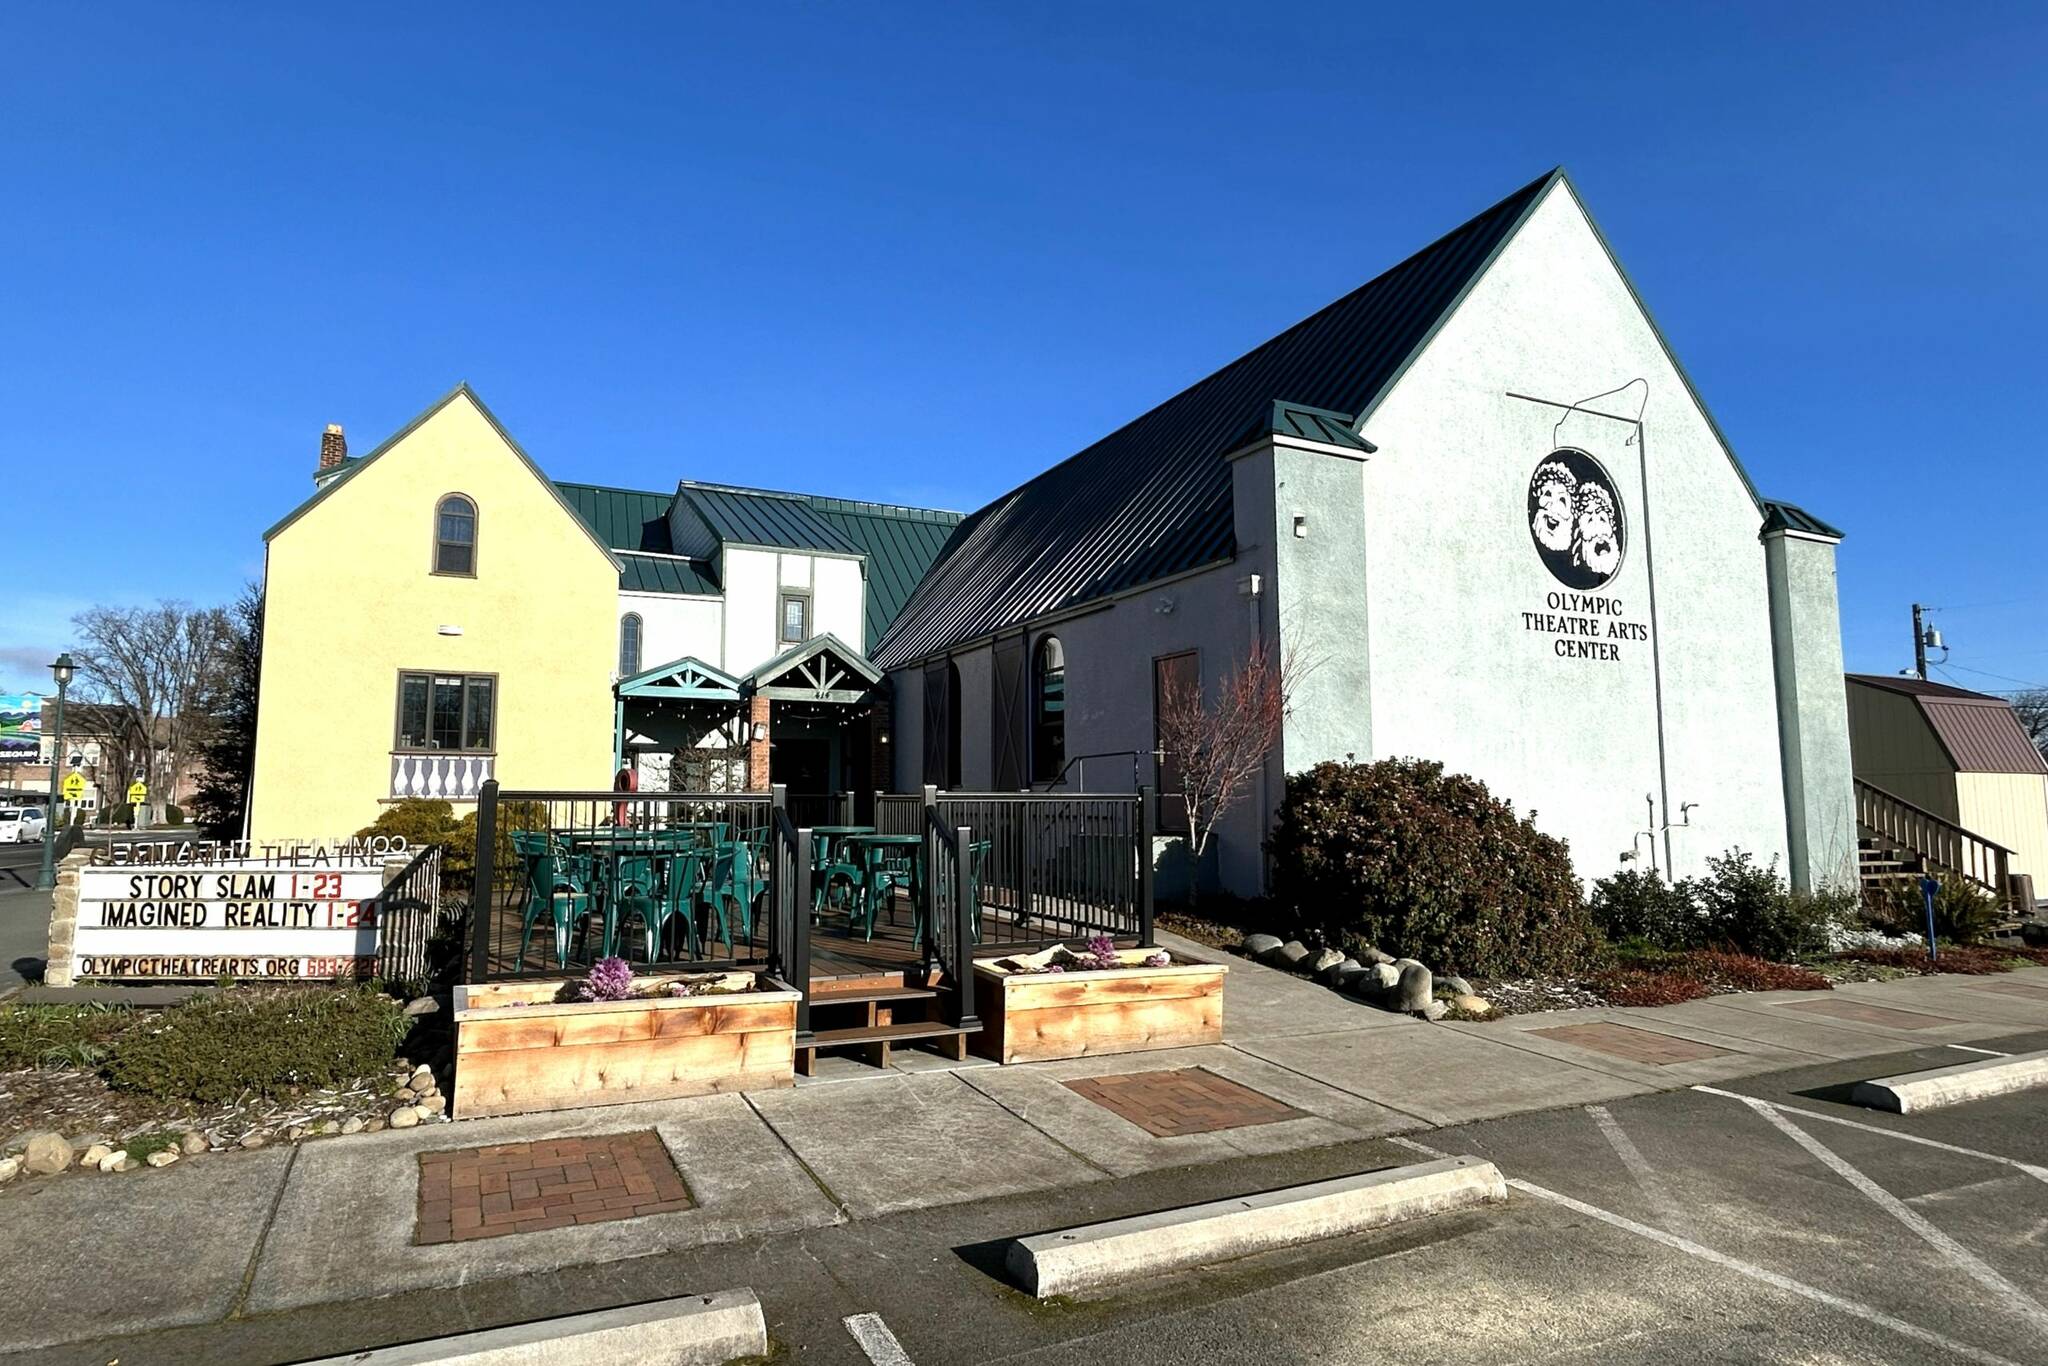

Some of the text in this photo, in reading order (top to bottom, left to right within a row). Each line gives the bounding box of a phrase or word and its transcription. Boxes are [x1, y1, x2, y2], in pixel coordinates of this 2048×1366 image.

[1547, 592, 1623, 616] OLYMPIC
[1522, 612, 1648, 641] THEATRE ARTS
[1554, 639, 1621, 661] CENTER
[260, 845, 385, 867] THEATRE
[129, 874, 342, 899] STORY SLAM 1-23
[101, 901, 378, 928] IMAGINED REALITY 1-24
